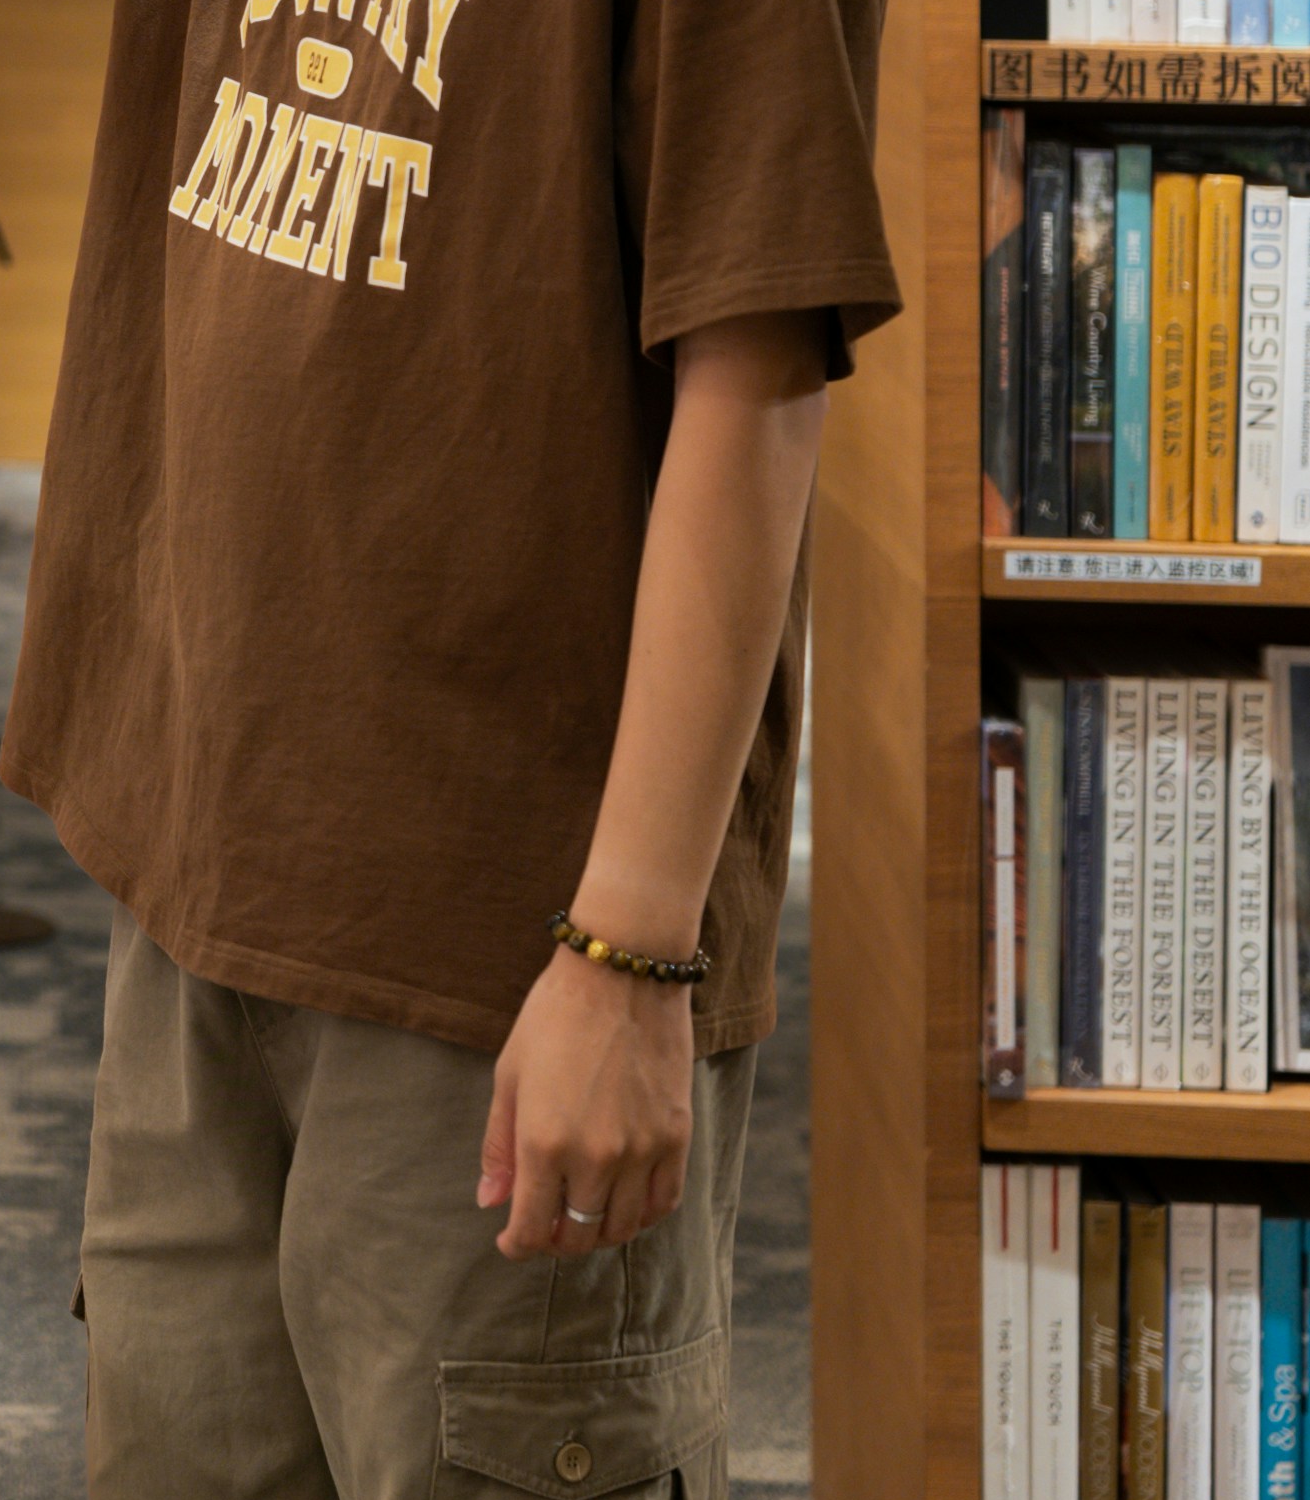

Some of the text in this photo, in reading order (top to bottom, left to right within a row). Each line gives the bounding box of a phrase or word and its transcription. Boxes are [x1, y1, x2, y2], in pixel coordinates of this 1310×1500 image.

[990, 50, 1310, 104] 图书如需拆阅
[168, 77, 433, 291] MOMENT
[1083, 266, 1108, 426] Wine Country Living
[1246, 204, 1283, 431] BIO DESIGN
[1110, 688, 1137, 1047] LIVING IN THE FOREST
[1151, 692, 1179, 1050] LIVING IN THE FOREST
[1192, 690, 1218, 1048] LIVING IN THE DESERT
[1238, 692, 1263, 1053] LIVING BY THE OCEAN
[998, 1318, 1013, 1426] THE TOUCH
[1047, 1318, 1062, 1427] THE TOUCH
[1086, 1312, 1117, 1414] Hollywood
[1133, 1316, 1165, 1416] Hollywood
[1179, 1334, 1204, 1393] TOP
[1227, 1337, 1252, 1396] TOP
[1268, 1364, 1299, 1424] Spa
[1268, 1425, 1296, 1452] &
